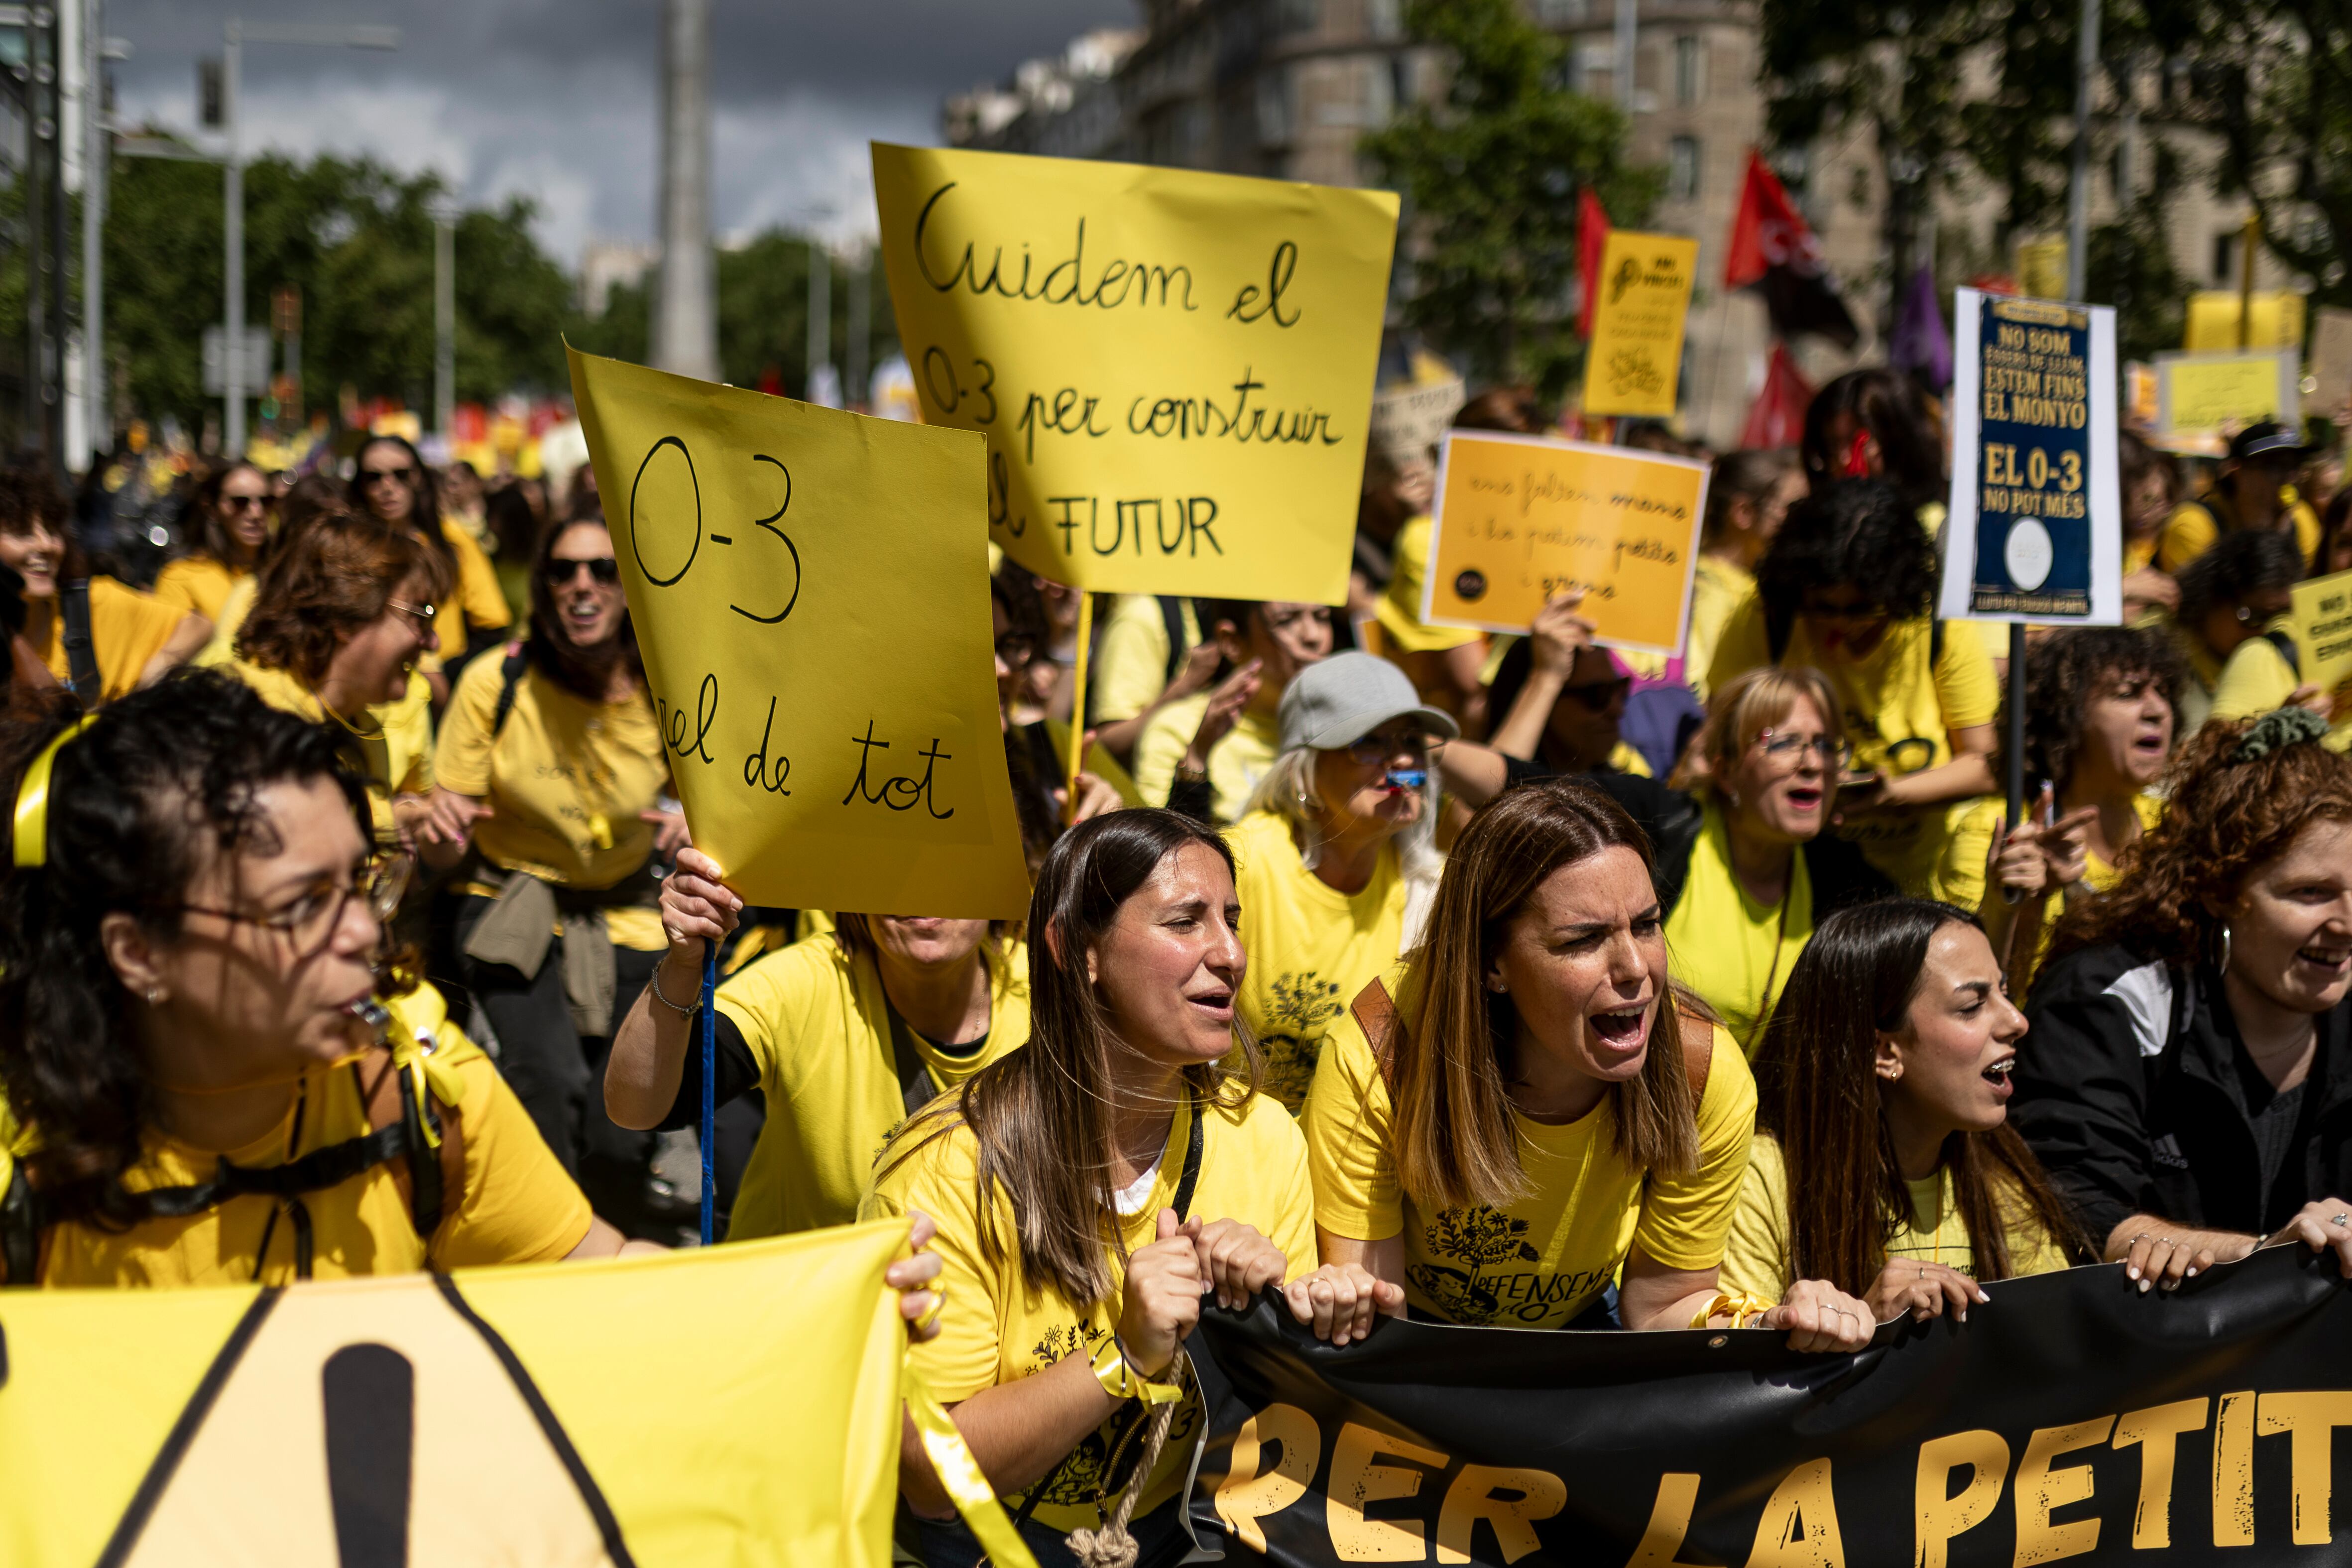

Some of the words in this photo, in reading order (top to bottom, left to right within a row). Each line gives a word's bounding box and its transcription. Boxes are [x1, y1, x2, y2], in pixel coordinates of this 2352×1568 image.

[915, 182, 1198, 310] Cuidem
[1225, 240, 1301, 329] el
[1998, 323, 2025, 351] NO
[2027, 327, 2071, 357] SOM
[1985, 366, 2041, 397] ESTEM
[2043, 371, 2086, 400] FINS
[1019, 387, 1111, 465] per
[1126, 365, 1343, 447] construir
[1984, 392, 2009, 421] EL
[2011, 395, 2087, 430] MONYO
[1984, 442, 2024, 487] EL
[2027, 446, 2083, 492] 0-3
[1611, 492, 1687, 522] mans
[1984, 487, 2009, 513] NO
[2011, 488, 2042, 515] POT
[2044, 490, 2086, 519] MÉS
[630, 436, 801, 624] 0-3
[1047, 498, 1224, 559] FUTUR
[1614, 539, 1678, 574] petits
[744, 696, 791, 797] de
[842, 719, 955, 820] tot
[1477, 1268, 1605, 1304] DEFENSEM
[1215, 1404, 1567, 1565] PER
[1624, 1458, 1846, 1568] LA
[1915, 1390, 2352, 1568] PETIT
